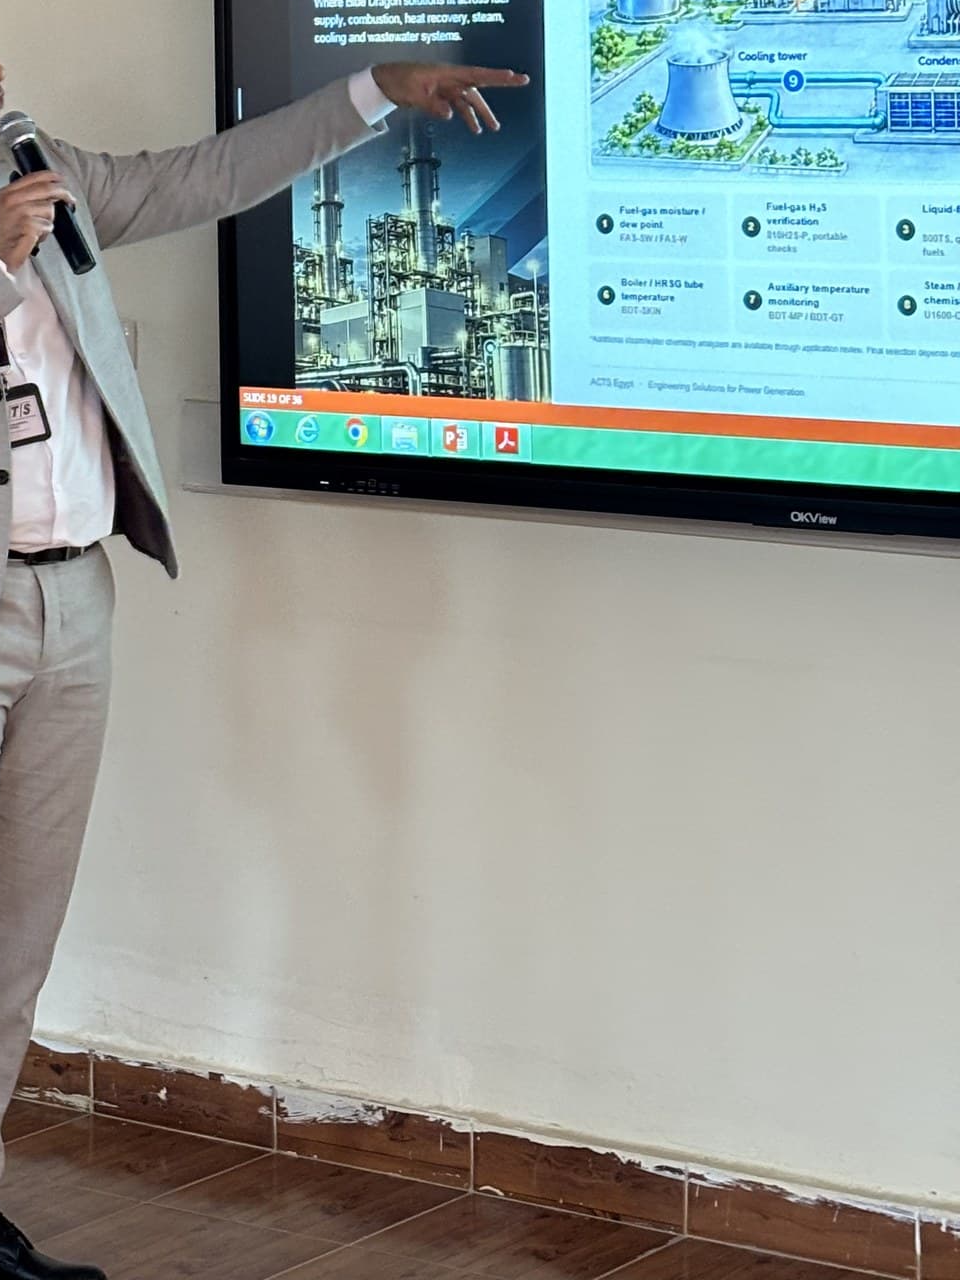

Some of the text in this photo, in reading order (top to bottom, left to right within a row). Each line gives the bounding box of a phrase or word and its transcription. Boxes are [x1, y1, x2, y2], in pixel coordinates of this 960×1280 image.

[314, 14, 346, 28] supply,
[348, 13, 403, 25] combustion,
[427, 14, 470, 26] recovery,
[314, 32, 347, 46] cooling
[348, 31, 366, 42] and
[739, 51, 807, 62] Cooling tower
[919, 56, 960, 65] Conden
[620, 206, 657, 216] Fuel-gas
[766, 202, 806, 212] Fuel-gas
[640, 221, 663, 229] point
[767, 217, 819, 225] verification
[621, 278, 647, 287] Boiler
[925, 281, 955, 290] Steam
[812, 285, 870, 294] temperature
[621, 293, 675, 302] temperature
[924, 296, 960, 305] chemis
[768, 299, 819, 308] monitoring
[243, 392, 265, 403] SLIDE
[790, 511, 837, 525] OKView
